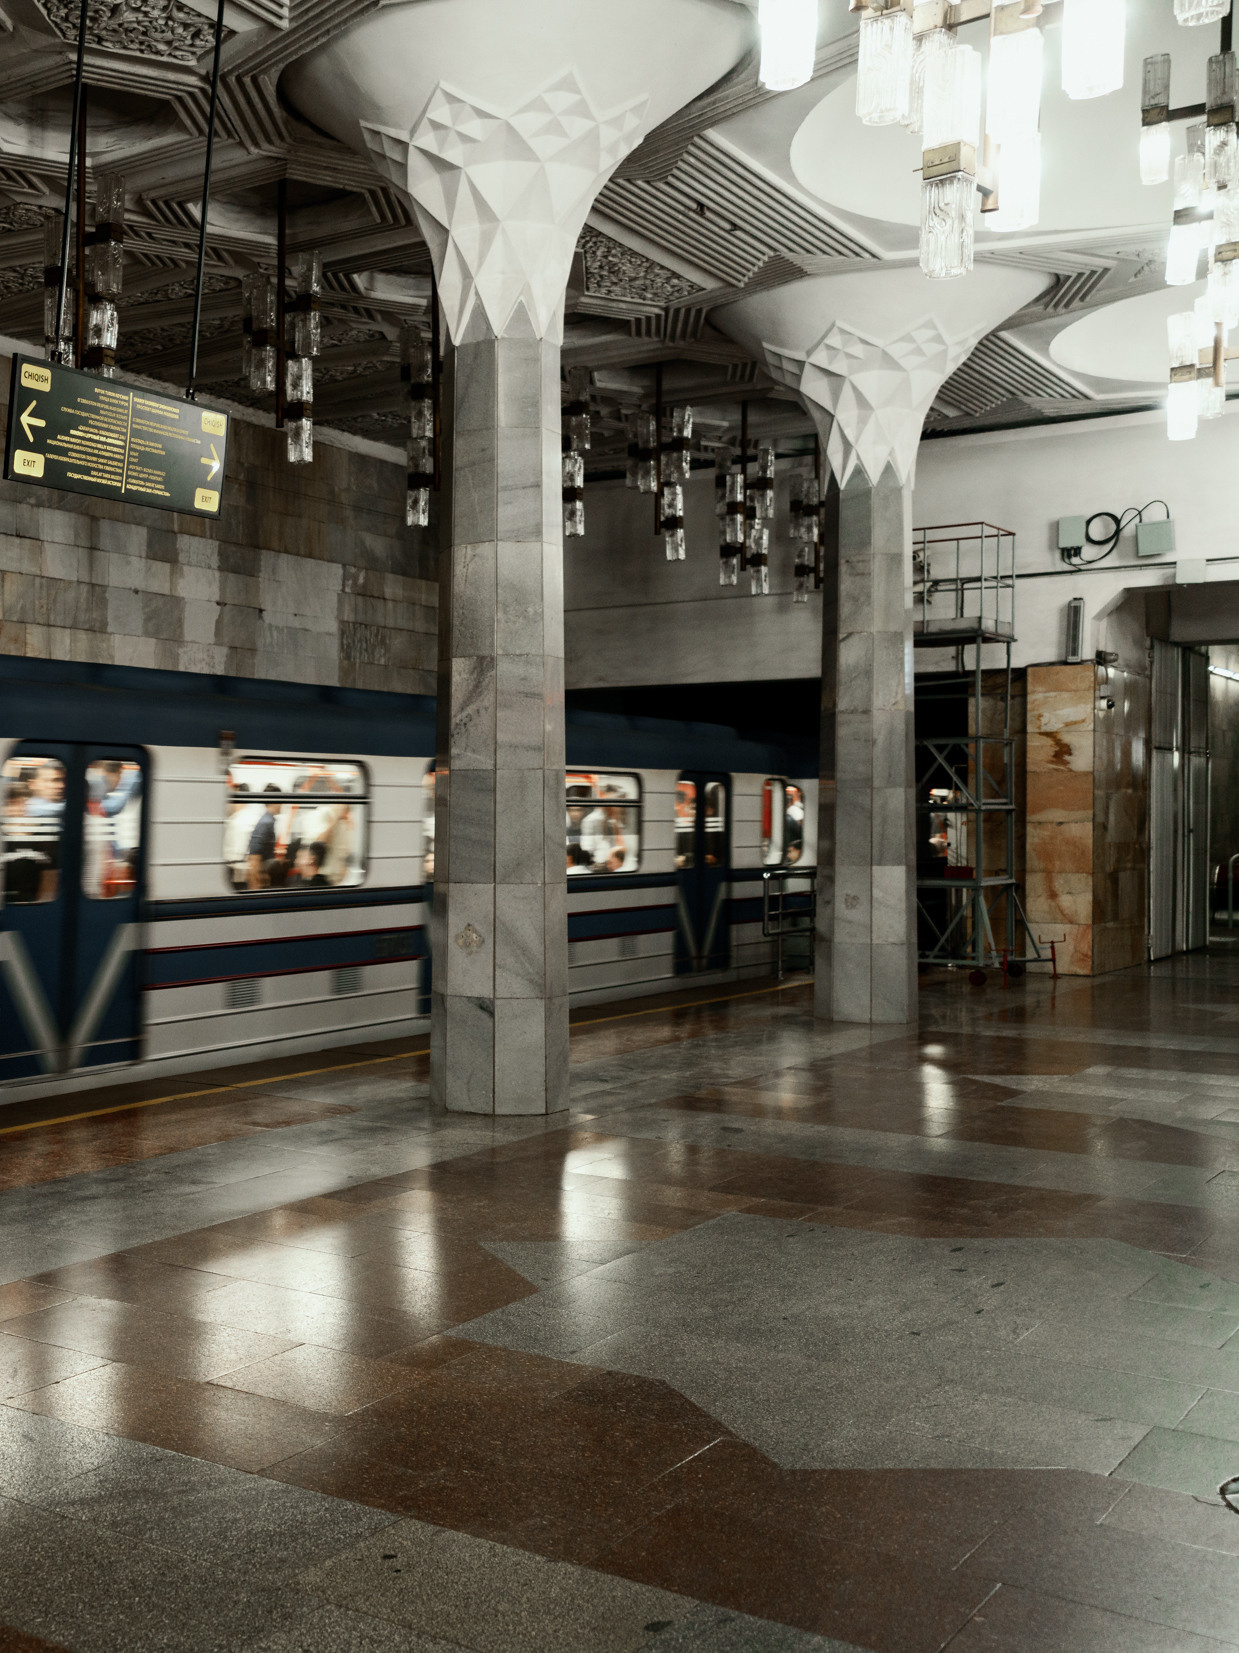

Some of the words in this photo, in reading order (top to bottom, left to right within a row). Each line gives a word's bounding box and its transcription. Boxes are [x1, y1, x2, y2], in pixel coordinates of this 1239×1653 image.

[24, 371, 48, 384] CHIQISH
[23, 459, 36, 468] EXIT
[201, 495, 212, 504] EXIT
